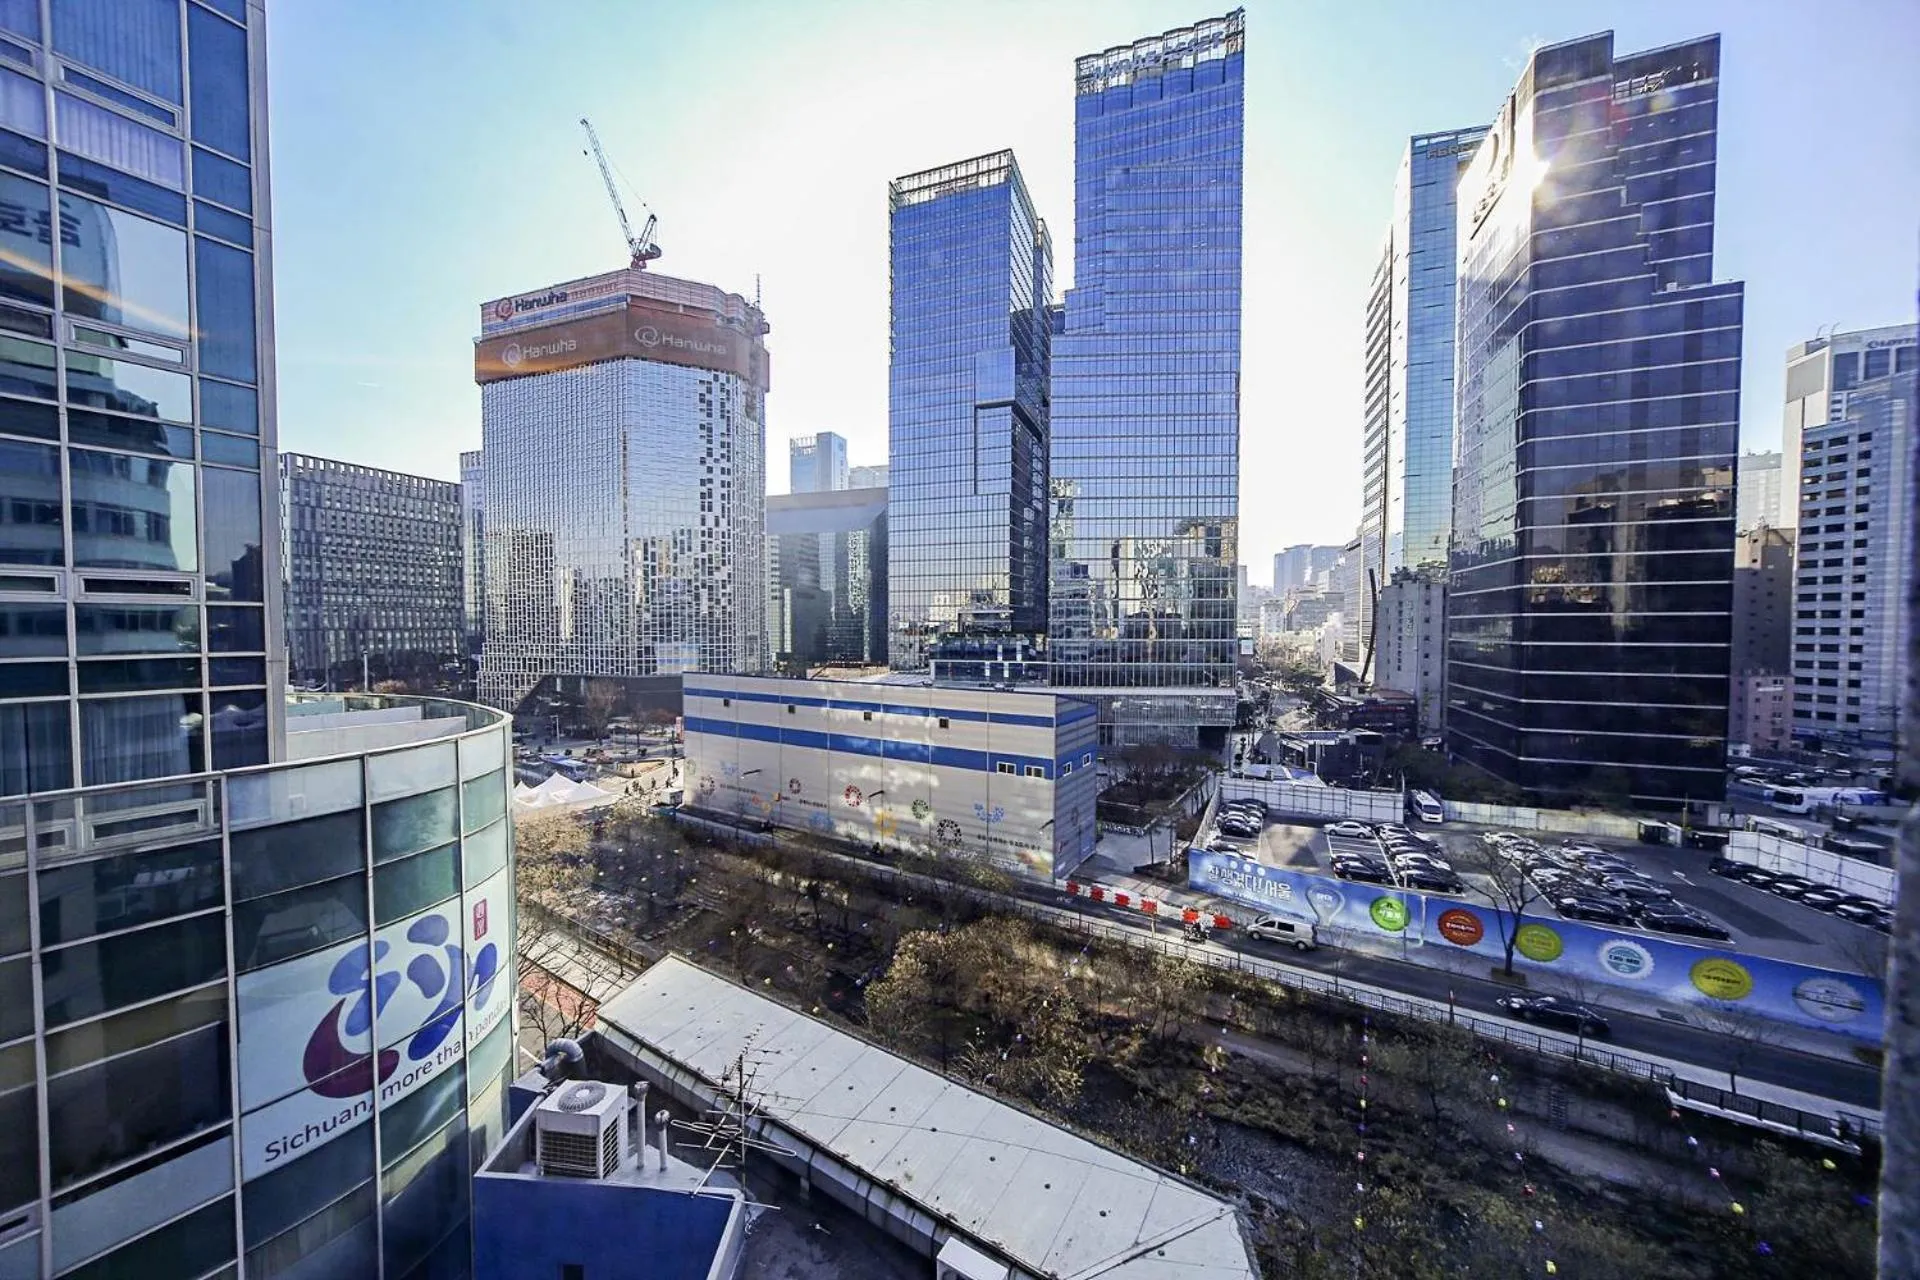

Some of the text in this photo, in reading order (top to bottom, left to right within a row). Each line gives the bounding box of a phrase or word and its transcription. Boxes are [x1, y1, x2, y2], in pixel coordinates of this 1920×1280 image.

[515, 291, 568, 312] Hanwha
[522, 339, 577, 359] Hanwha
[662, 332, 727, 355] Hanwha
[381, 1059, 433, 1101] more
